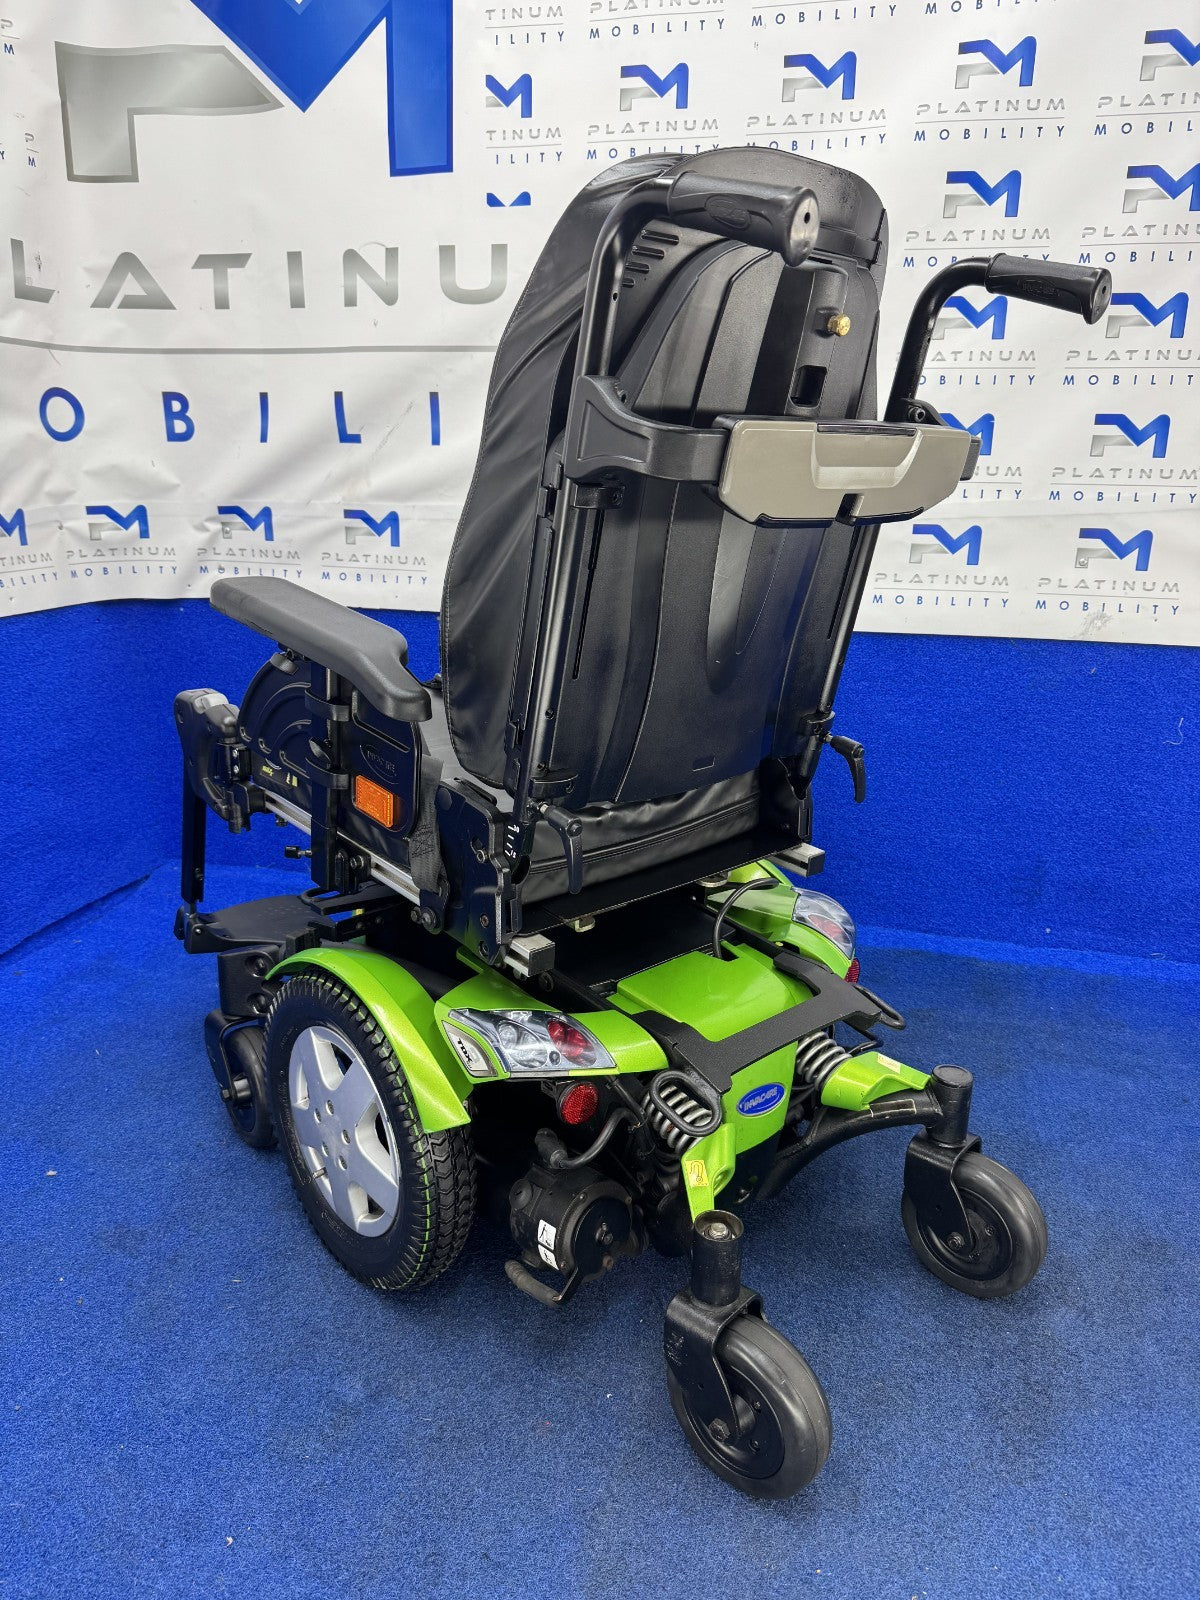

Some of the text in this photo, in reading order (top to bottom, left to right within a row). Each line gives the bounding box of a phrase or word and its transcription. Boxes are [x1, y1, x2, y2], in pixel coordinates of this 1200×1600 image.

[751, 5, 897, 27] MOBILITY
[589, 18, 725, 39] MOBILITY
[916, 98, 1065, 116] PLATINUM
[747, 109, 886, 127] PLATINUM
[588, 119, 718, 135] PLATINUM
[914, 126, 1065, 142] MOBILITY
[1094, 120, 1193, 135] MOBIL
[906, 228, 1050, 242] PLATINUM
[1082, 223, 1200, 238] PLATIN
[1066, 350, 1200, 361] PLATINU
[1052, 467, 1197, 480] PLATINUM
[1049, 491, 1197, 503] MOBILITY
[66, 547, 176, 559] PLATINUM
[197, 548, 301, 560] PLATINUM
[322, 552, 427, 566] PLATINUM
[70, 566, 177, 578] MOBILITY
[200, 566, 302, 578] MOBILITY
[322, 571, 427, 584] MOBILITY
[875, 573, 1009, 586] PLATINUM
[1038, 577, 1180, 593] PLATINUM
[872, 594, 1009, 607] MOBILITY
[1035, 600, 1179, 615] MOBILITY
